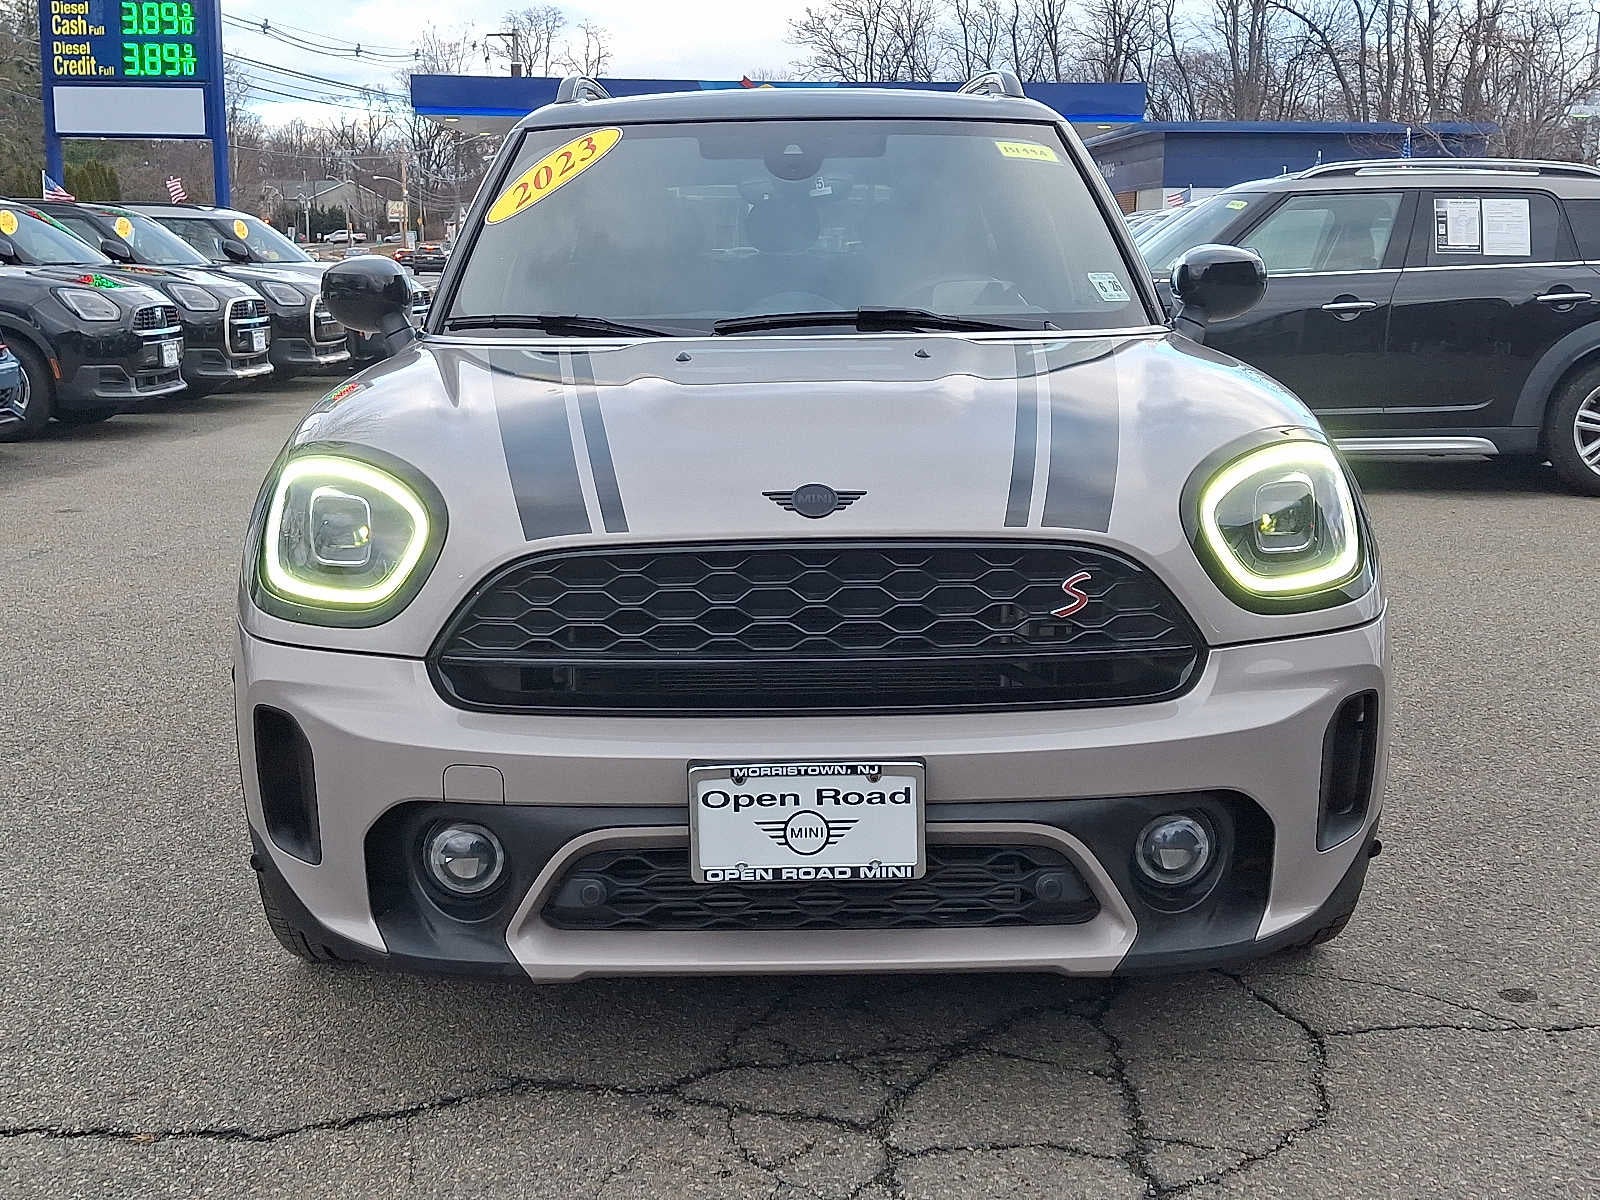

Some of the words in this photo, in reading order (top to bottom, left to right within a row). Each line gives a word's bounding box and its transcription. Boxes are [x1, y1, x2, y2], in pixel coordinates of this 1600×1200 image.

[51, 1, 89, 15] Diesel
[121, 2, 180, 35] 3.89
[51, 15, 88, 36] Cash
[88, 25, 105, 36] Full
[53, 41, 91, 55] Diesel
[53, 55, 97, 76] Credit
[98, 66, 115, 76] Full
[123, 42, 181, 76] 3.89
[512, 136, 598, 210] 2023
[1050, 571, 1092, 618] S
[732, 765, 852, 778] MORRISTOWN,
[857, 764, 879, 775] NJ
[701, 789, 801, 813] Open
[816, 786, 912, 807] Road
[790, 826, 825, 839] MINI
[705, 867, 774, 882] OPEN
[781, 867, 852, 880] ROAD
[859, 865, 913, 878] MINI
